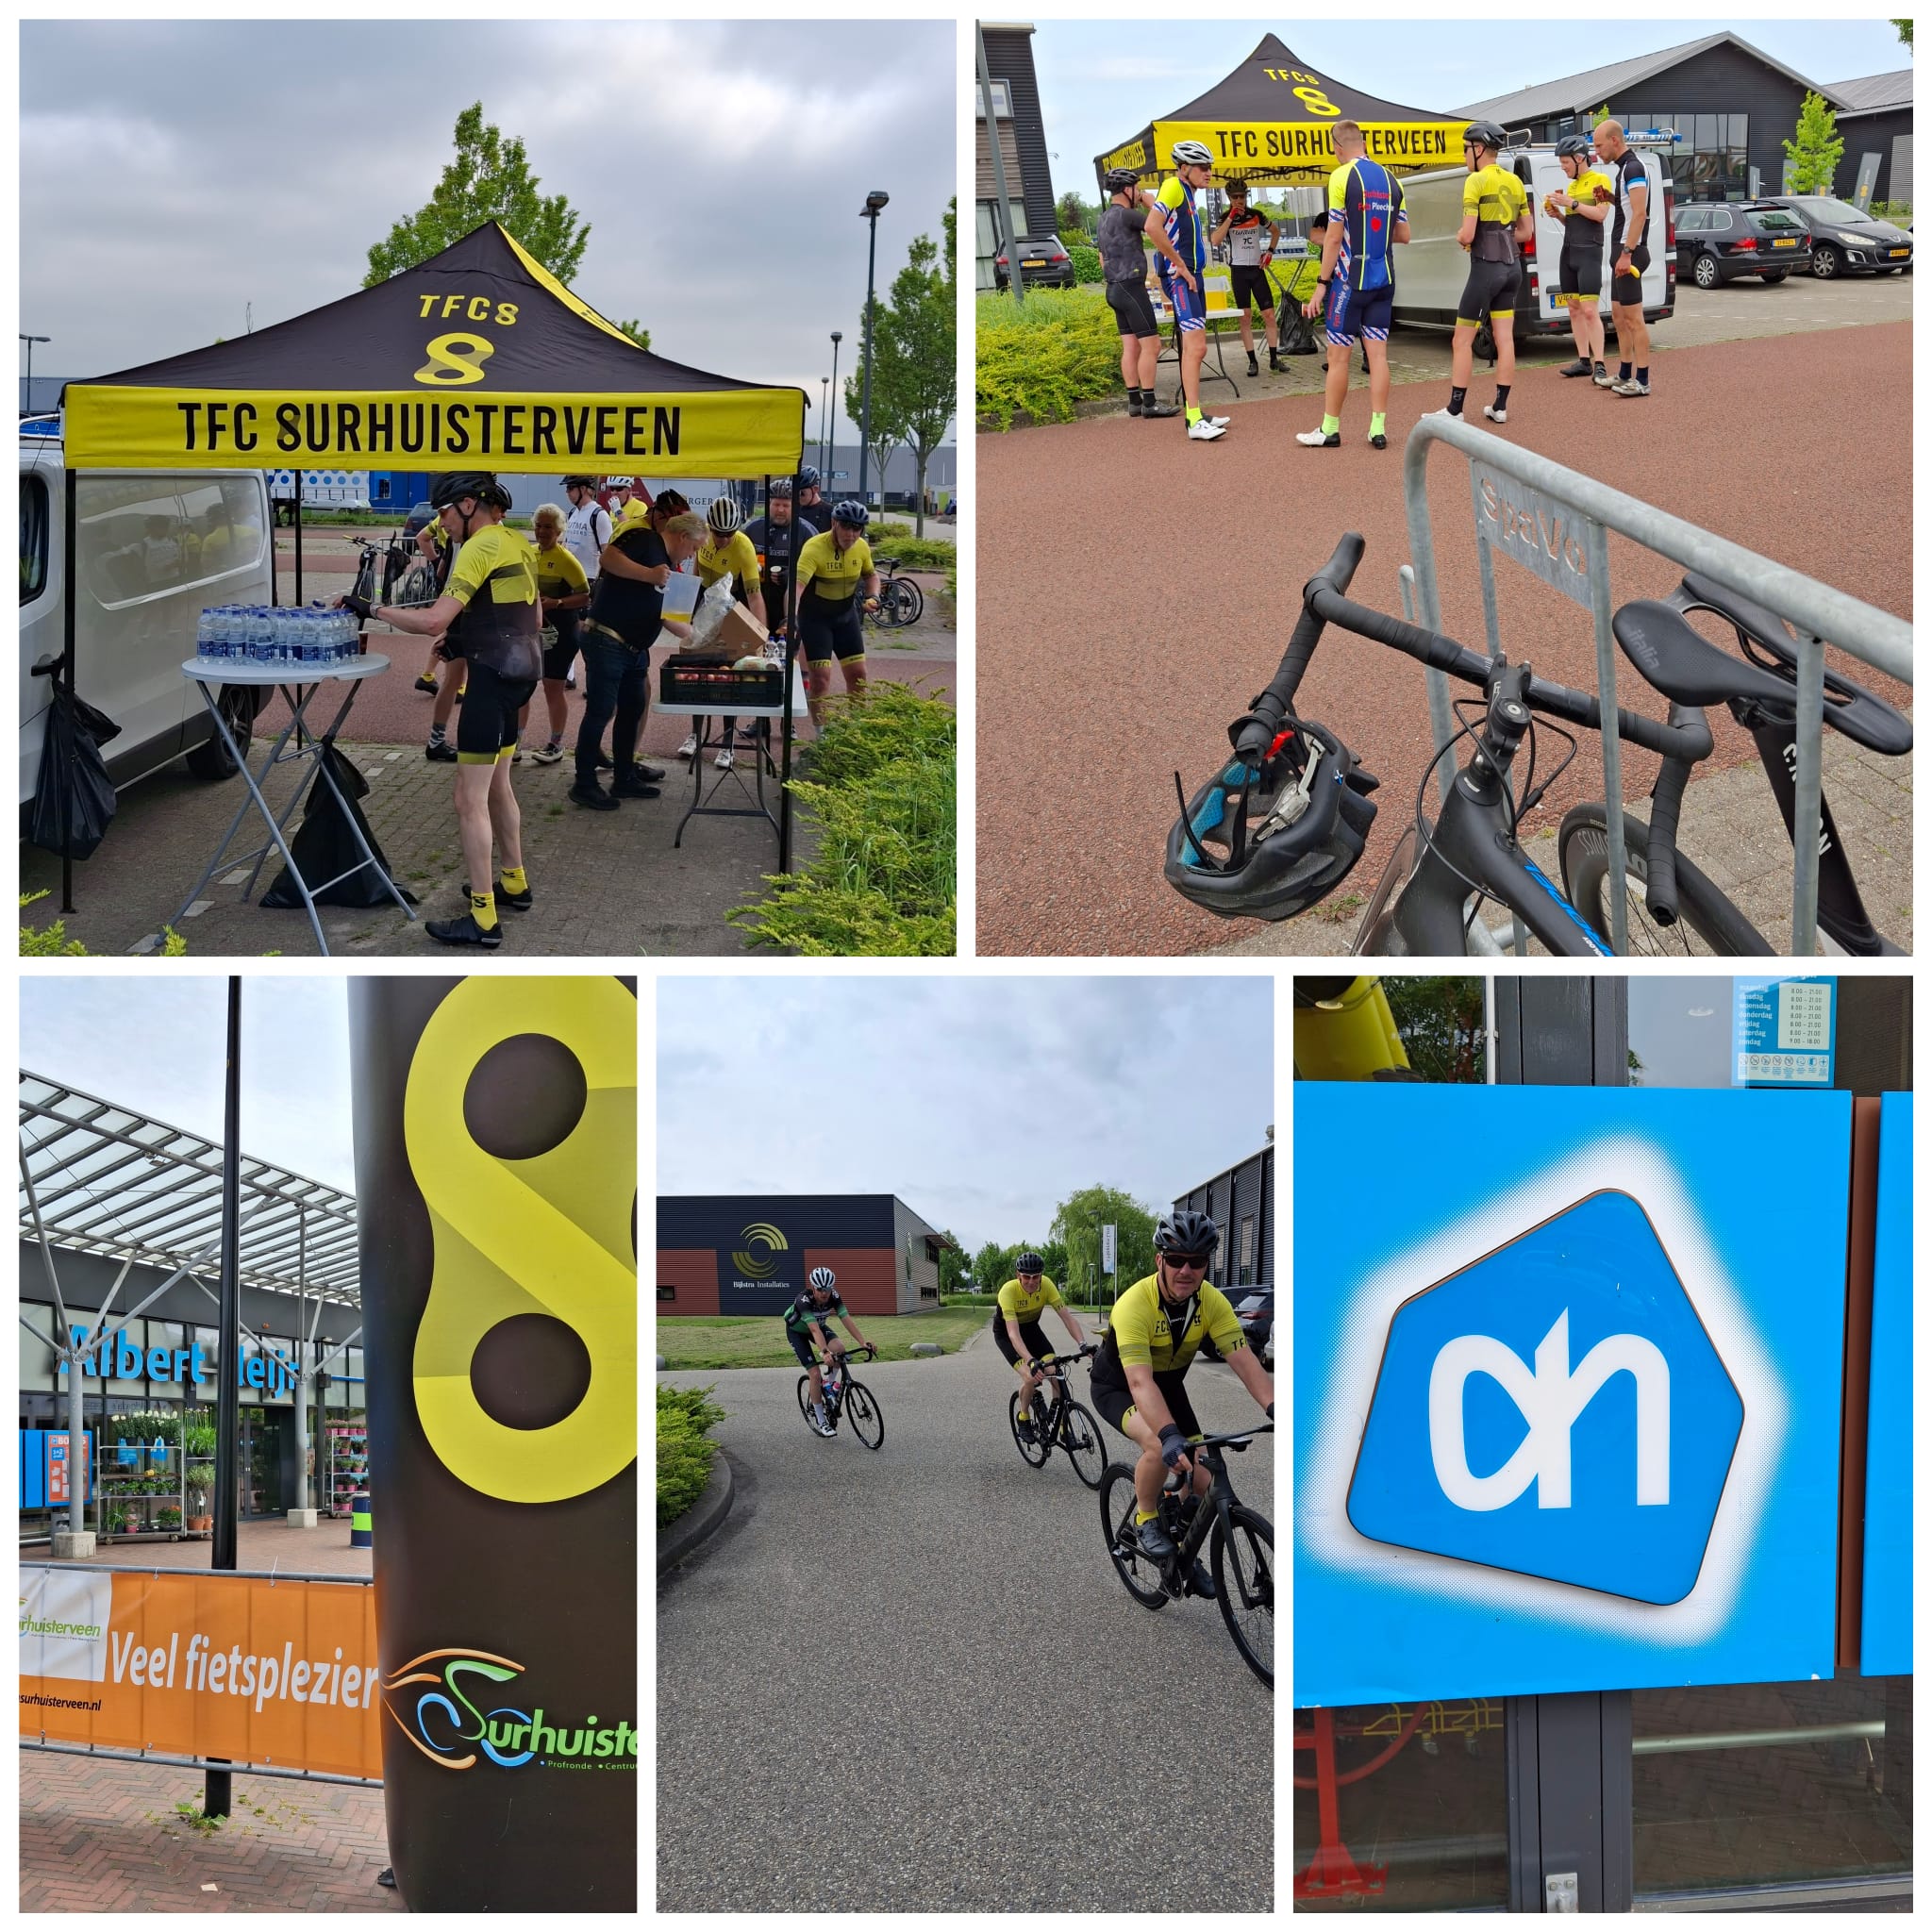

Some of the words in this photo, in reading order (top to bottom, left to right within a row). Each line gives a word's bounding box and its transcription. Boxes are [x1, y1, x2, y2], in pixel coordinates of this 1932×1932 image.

[1215, 130, 1257, 158] TFC
[1266, 130, 1446, 157] SURHUTERVEEN
[177, 403, 258, 452] TFC
[275, 403, 680, 456] SURHUISTERVEEN
[238, 1344, 301, 1399] eij
[58, 1437, 87, 1445] BOS
[111, 1631, 179, 1688] Veel
[185, 1634, 379, 1713] fietsplezier
[19, 1692, 102, 1711] surhuisterveen.nl
[548, 1759, 592, 1771] Profronde
[605, 1762, 638, 1771] Centru
